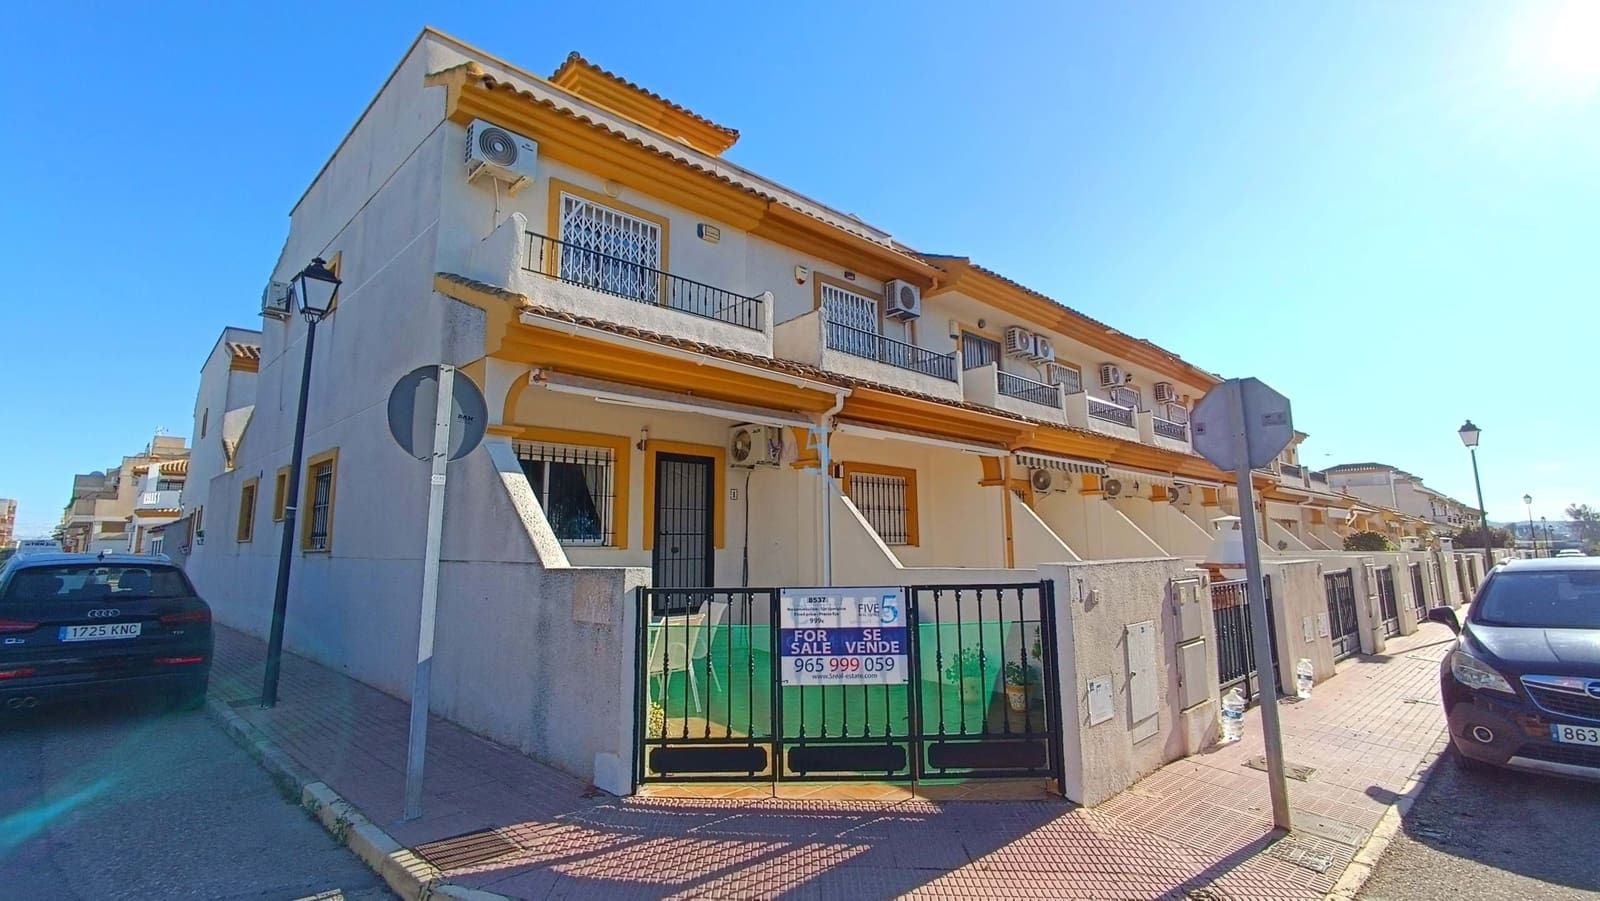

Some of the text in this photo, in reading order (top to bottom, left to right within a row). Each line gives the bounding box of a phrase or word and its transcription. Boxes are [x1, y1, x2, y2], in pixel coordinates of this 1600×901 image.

[858, 595, 898, 624] FIVE 5
[72, 624, 138, 638] 1725 KNC
[794, 630, 827, 642] FOR
[863, 629, 881, 641] SE
[791, 642, 832, 654] SALE
[845, 641, 900, 653] VENDE
[794, 657, 895, 672] 965 999 059
[1564, 727, 1598, 743] 863
